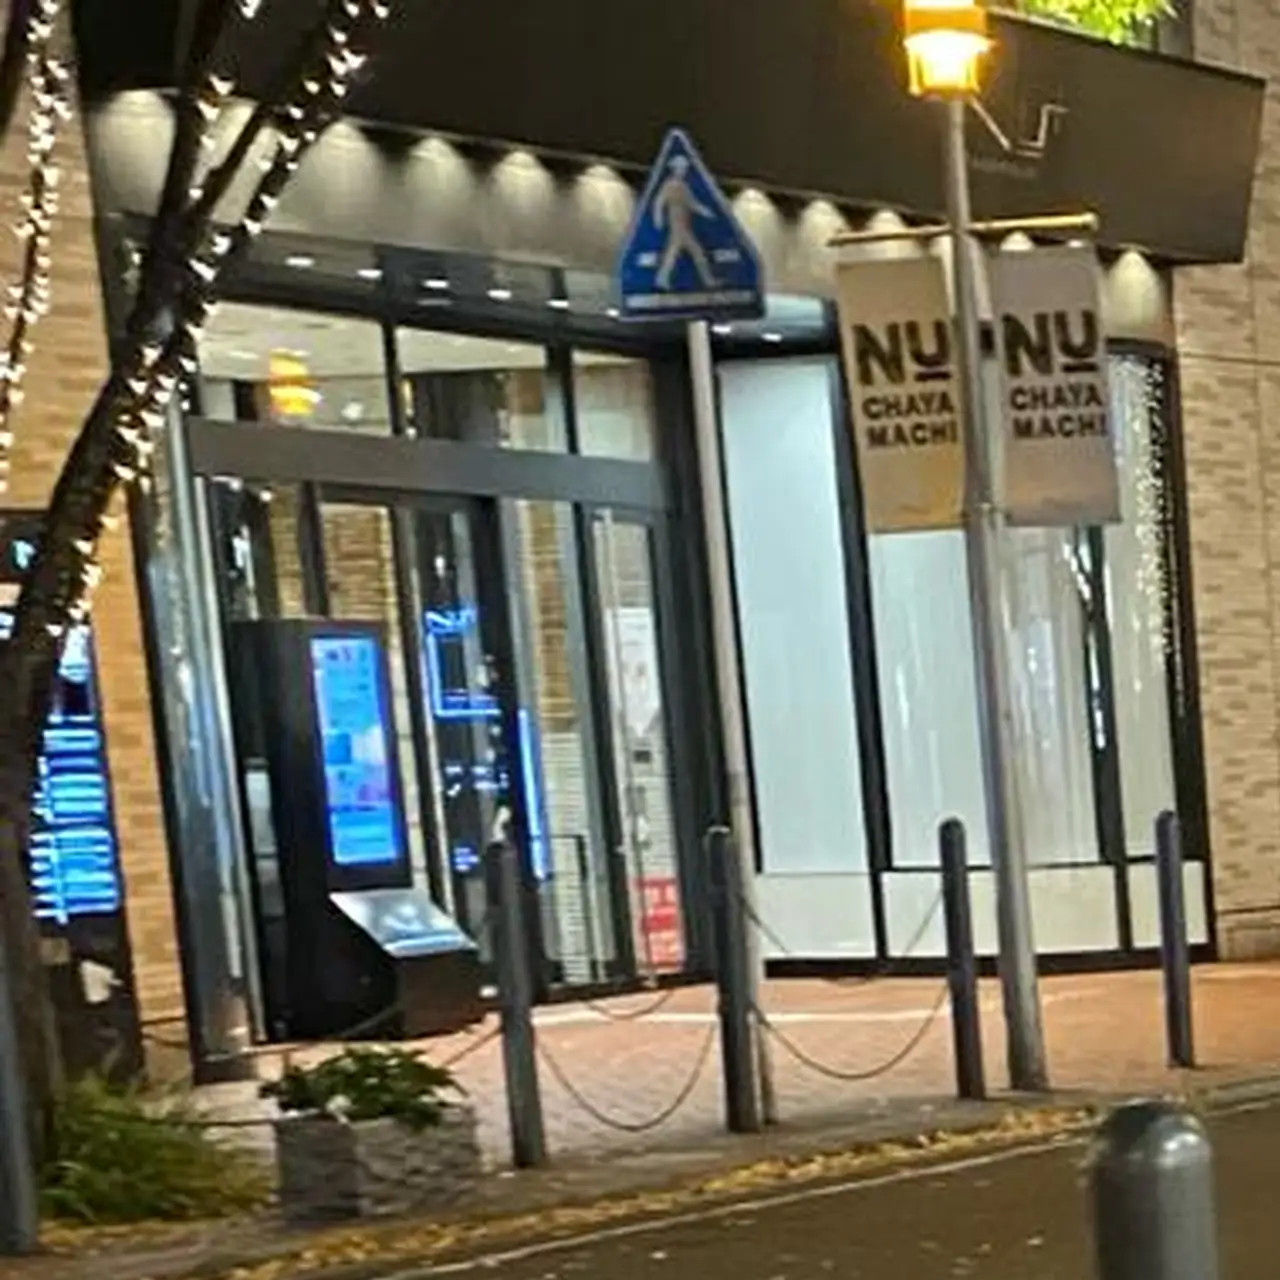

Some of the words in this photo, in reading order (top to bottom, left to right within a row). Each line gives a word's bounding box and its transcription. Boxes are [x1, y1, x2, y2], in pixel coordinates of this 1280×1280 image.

[852, 319, 951, 386] NU
[1002, 309, 1098, 377] NU
[862, 391, 955, 420] CHAYA
[1010, 382, 1102, 411] CHAYA
[866, 419, 958, 448] MACHI
[1013, 412, 1106, 438] MACHI
